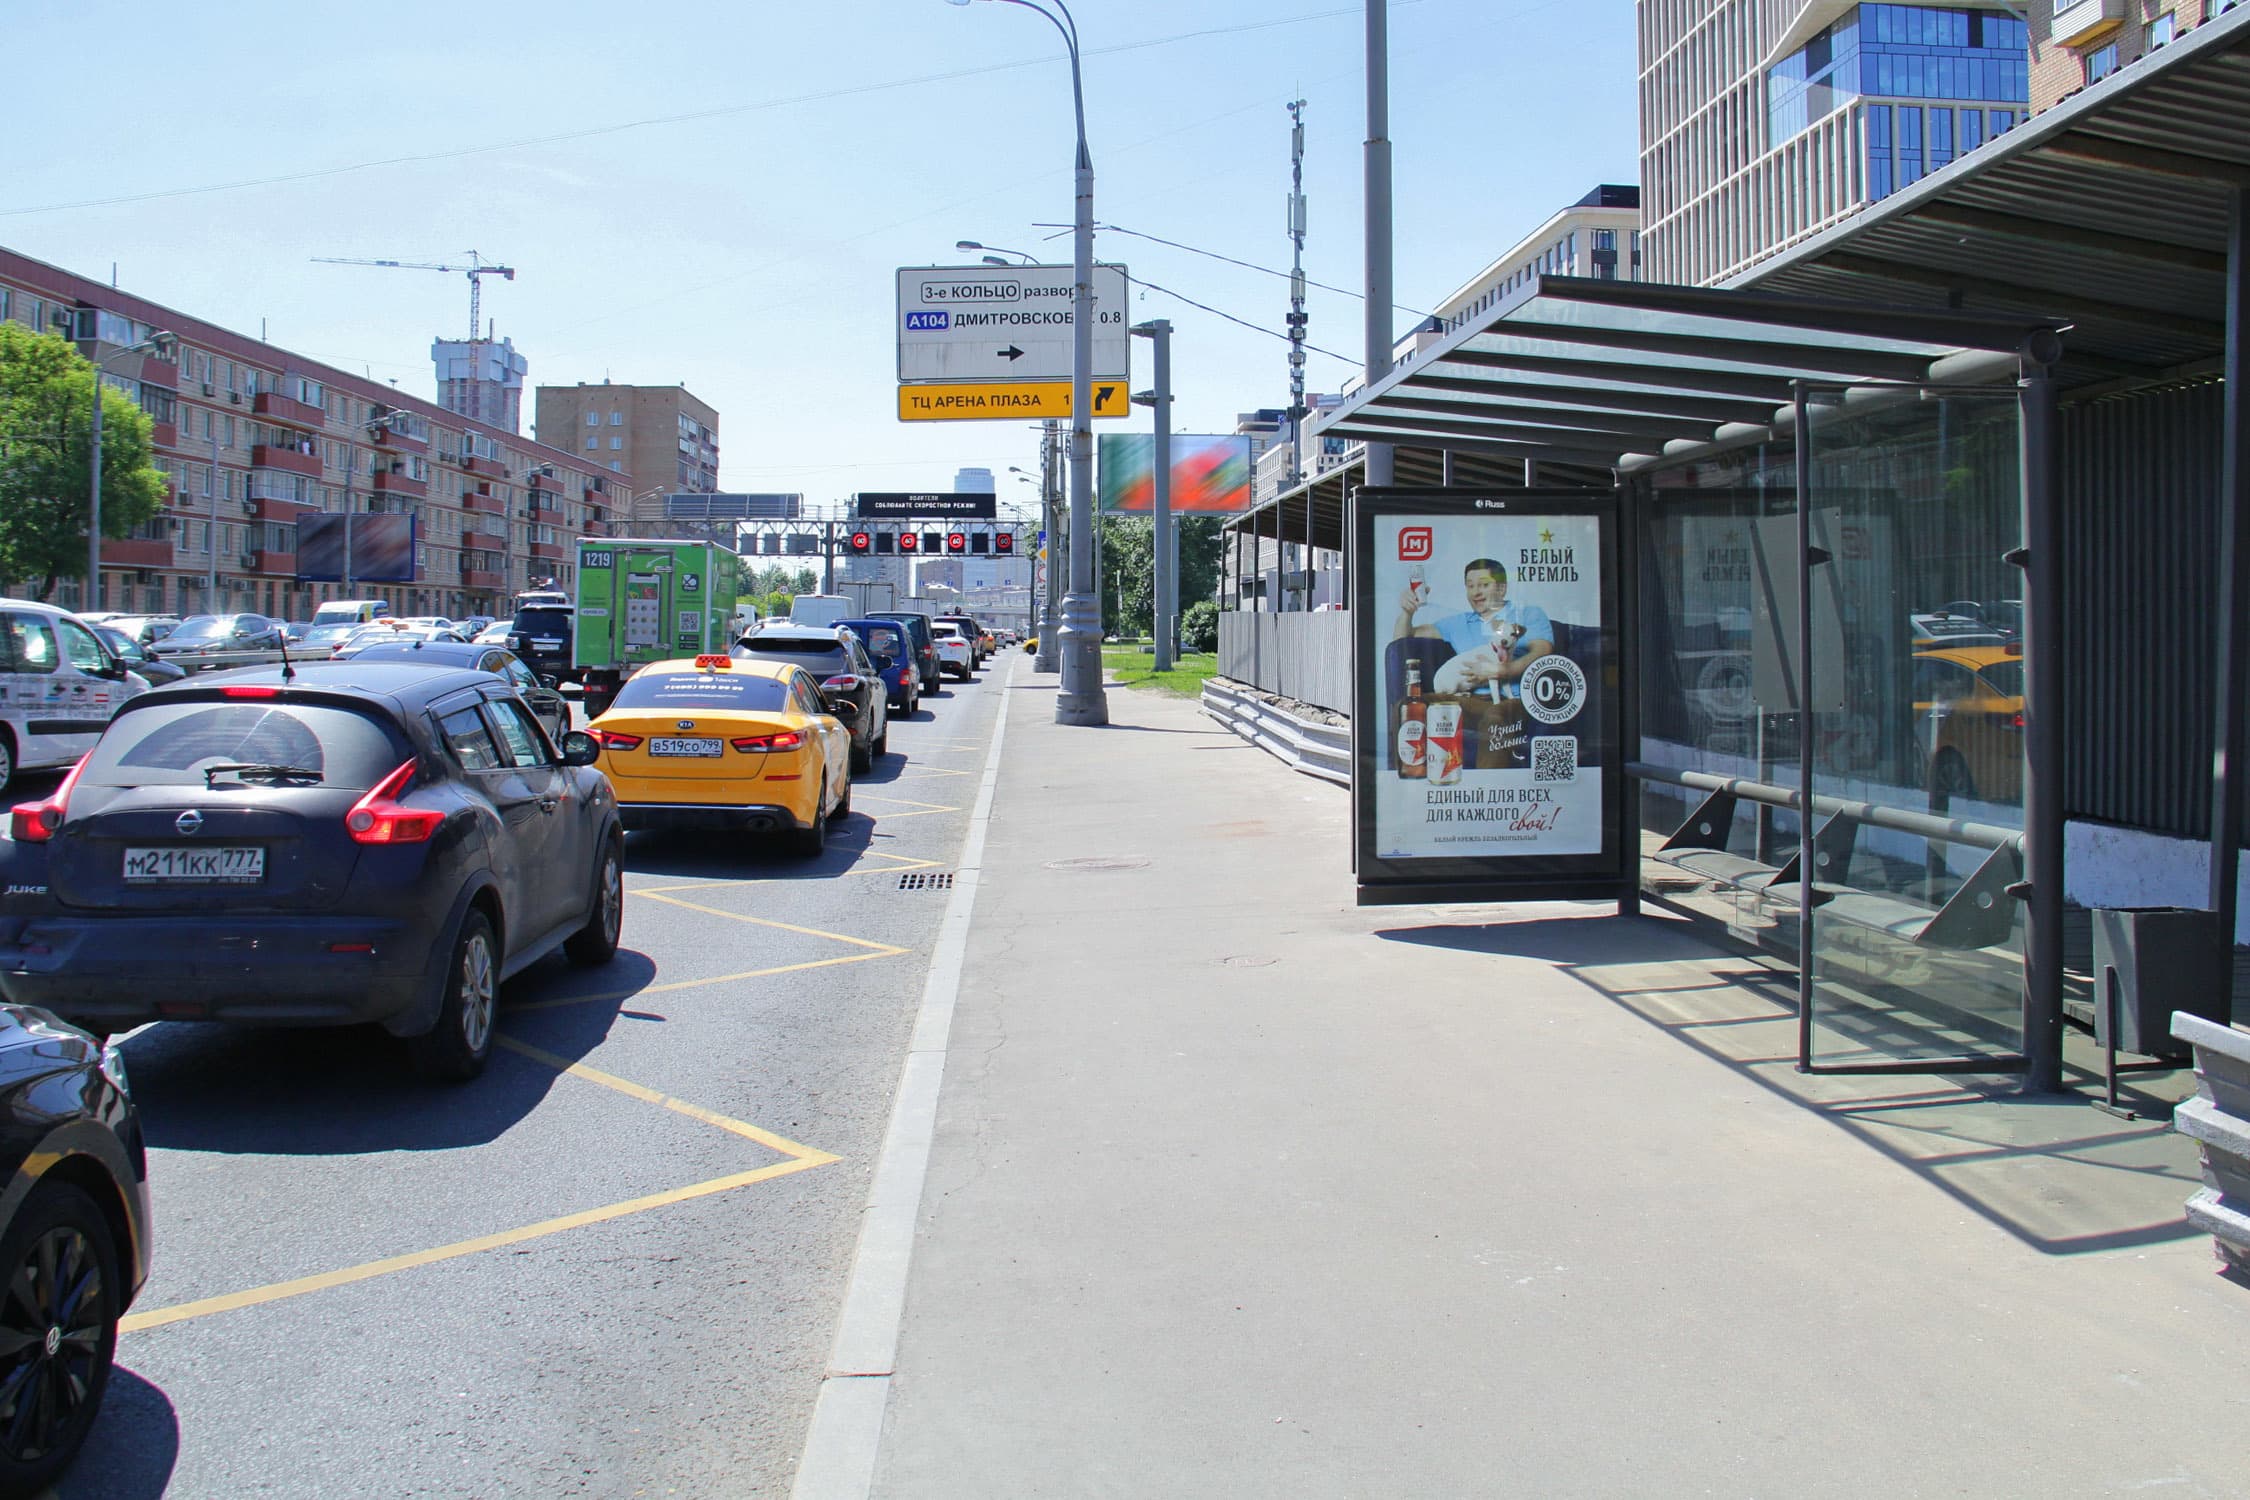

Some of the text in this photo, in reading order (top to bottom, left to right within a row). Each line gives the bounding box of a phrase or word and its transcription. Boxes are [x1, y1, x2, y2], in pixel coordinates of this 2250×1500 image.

[925, 286, 947, 299] 3-е
[951, 285, 1018, 301] КОЛЬЦО
[954, 312, 1074, 328] ДМИТРОВСКОЕ
[1100, 311, 1121, 324] 0.8
[911, 396, 931, 410] ТЦ
[935, 395, 987, 408] АРЕНА
[990, 394, 1042, 407] ПЛАЗА
[585, 552, 611, 567] 1219
[1520, 545, 1574, 564] БЕЛЫЙ
[1517, 566, 1579, 582] КРЕМЛЬ
[1523, 658, 1584, 691] БЕЗАЛКОГОЛЬНАЯ
[1528, 703, 1578, 721] ПРОДУКЦИЯ
[701, 740, 719, 749] 799
[1426, 787, 1485, 805] ЕДИНЫЙ
[1487, 789, 1514, 805] ДЛЯ
[1426, 803, 1562, 831] ДЛЯ КАЖДОГО свой!
[223, 850, 258, 868] 777
[3, 884, 49, 895] JUKE
